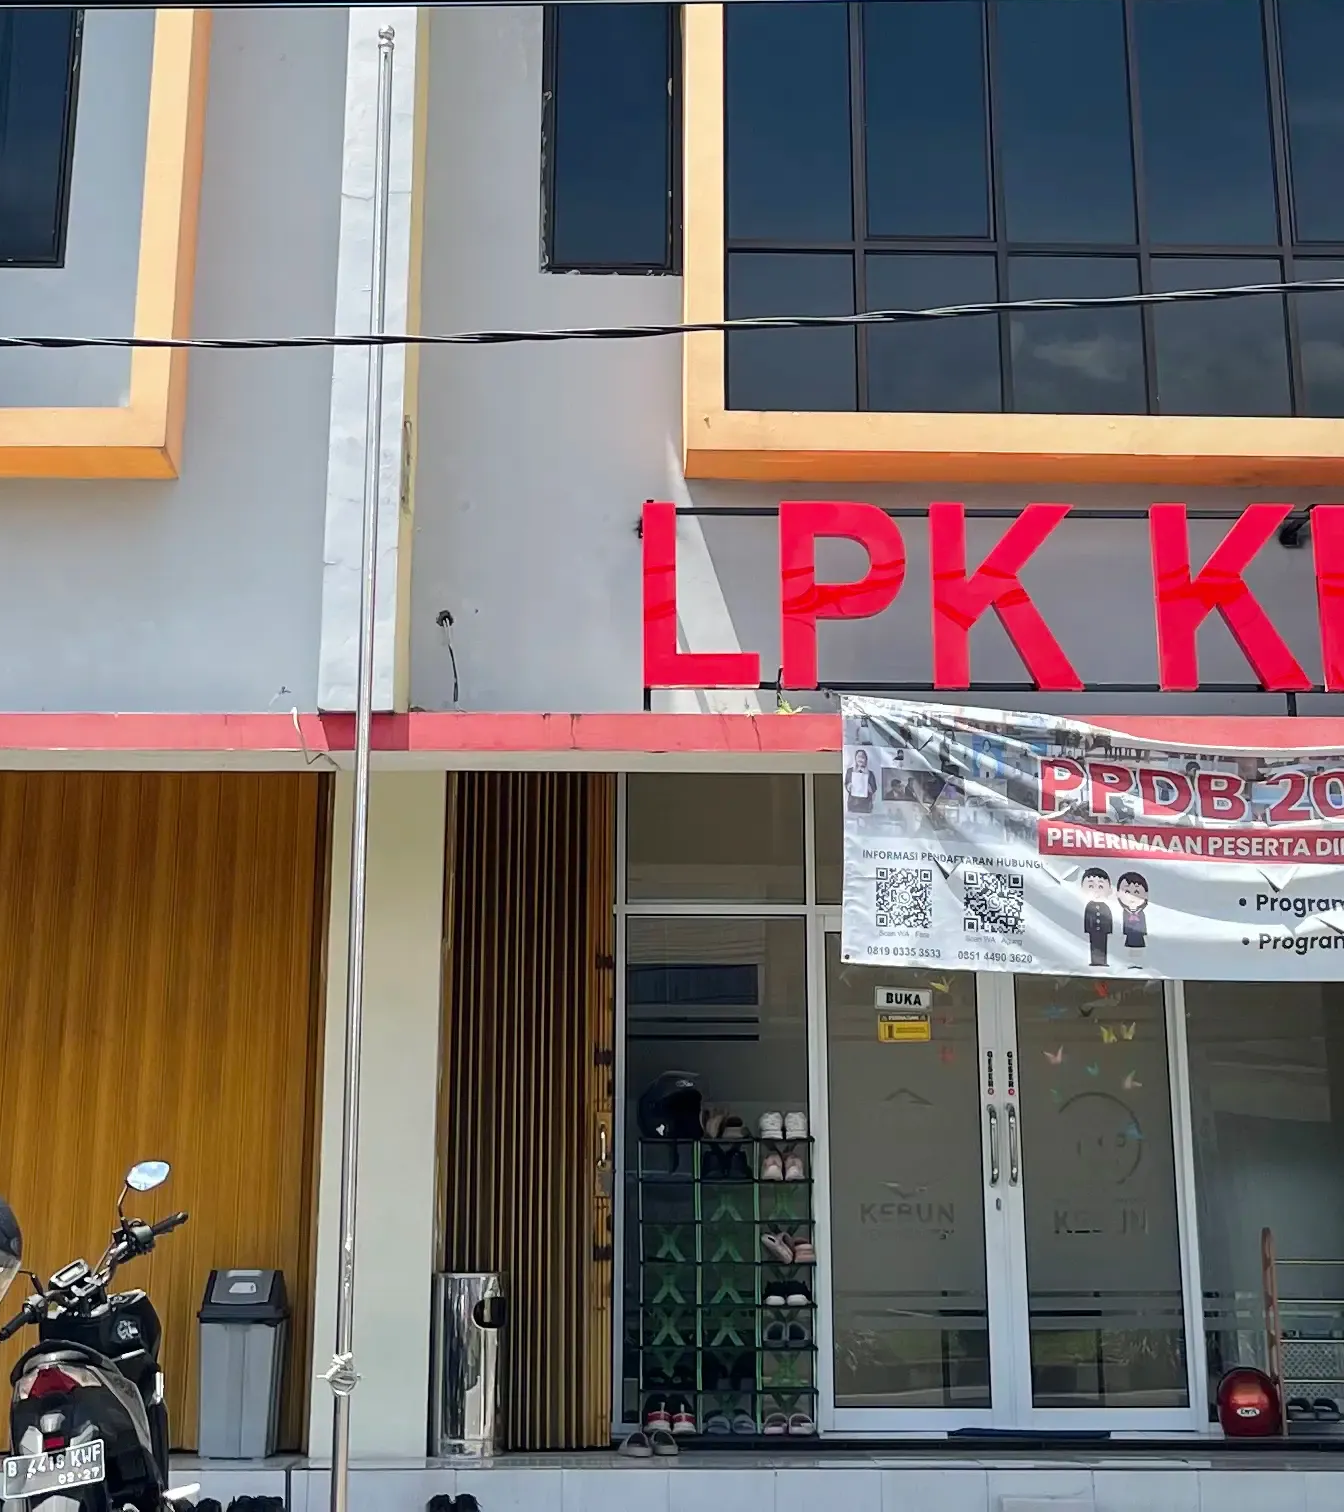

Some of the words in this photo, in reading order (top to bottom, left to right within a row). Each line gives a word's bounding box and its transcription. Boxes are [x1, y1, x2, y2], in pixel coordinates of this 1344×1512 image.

[644, 501, 1085, 691] LPK
[1038, 758, 1249, 824] PPDB
[1047, 826, 1203, 855] PENERIMAAN
[1208, 834, 1311, 857] PESERTA
[862, 849, 918, 861] INFORMASI
[921, 852, 994, 867] PENDAFTARAN
[996, 857, 1043, 869] HUBUNGI
[867, 945, 890, 956] 0819
[885, 991, 922, 1006] BUKA
[7, 1461, 17, 1477] B
[70, 1443, 101, 1468] KWF
